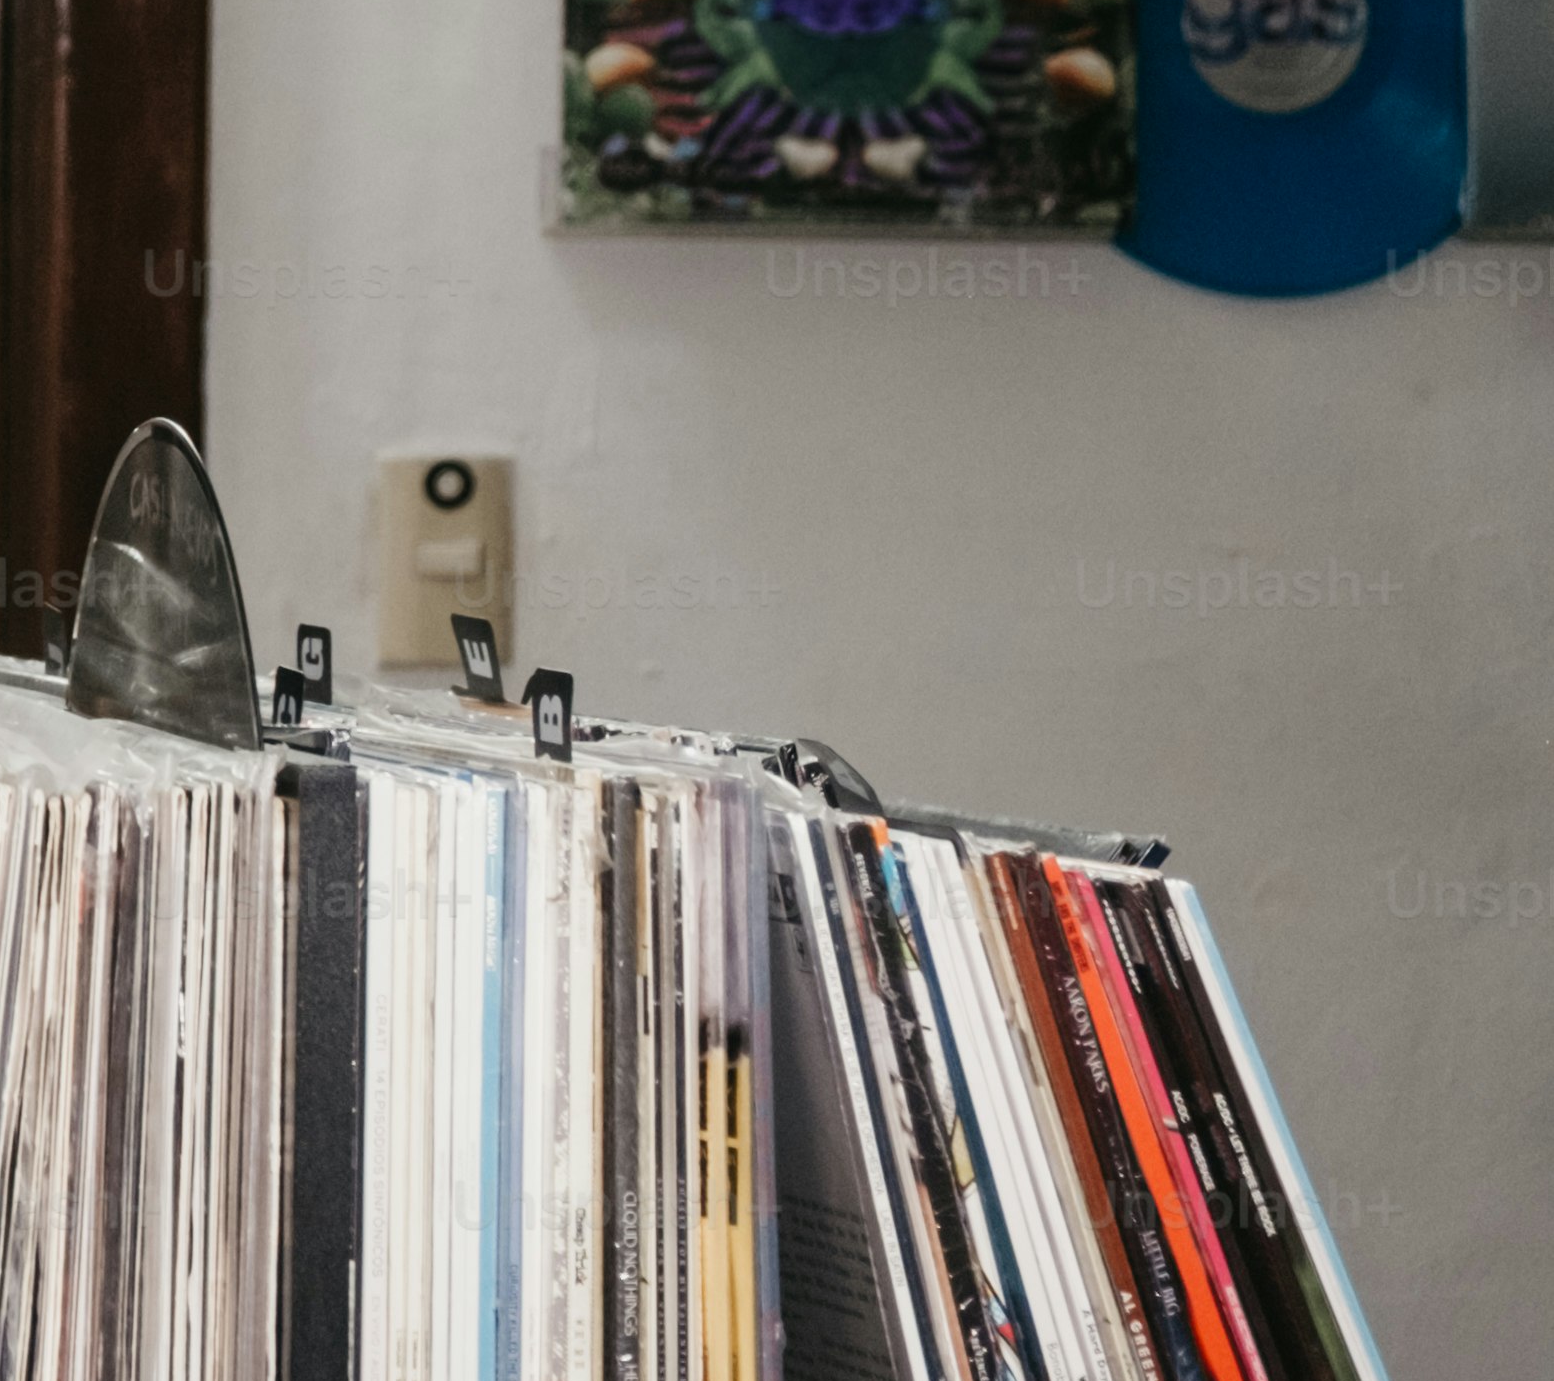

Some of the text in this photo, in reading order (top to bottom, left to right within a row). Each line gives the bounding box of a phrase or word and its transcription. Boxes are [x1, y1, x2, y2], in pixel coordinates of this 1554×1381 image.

[302, 636, 323, 681] G
[462, 638, 493, 679] E
[539, 694, 563, 745] B
[820, 940, 840, 989] HOLIDAY
[374, 994, 387, 1051] CERATI
[831, 991, 847, 1021] WITH
[838, 1021, 852, 1044] RAY
[1057, 971, 1095, 1038] AARON
[1078, 1036, 1113, 1095] PARKS
[375, 1069, 385, 1083] 14
[372, 1089, 387, 1175] EPISODIOS
[860, 1125, 886, 1196] ORCHESTRA
[1185, 1130, 1217, 1193] POWERAGE
[1249, 1187, 1266, 1205] BE
[369, 1179, 386, 1278] SINFÓNICOS
[623, 1191, 637, 1247] CLOUD
[879, 1208, 894, 1239] LADY
[1255, 1203, 1279, 1238] ROCK
[886, 1240, 898, 1253] IN
[507, 1264, 519, 1315] CURIOSITY
[889, 1254, 905, 1288] SATIN
[623, 1251, 638, 1336] NOTHINGS
[1118, 1288, 1137, 1314] AL
[1157, 1285, 1182, 1318] BIG
[1081, 1307, 1091, 1319] A
[507, 1319, 518, 1353] KILLED
[573, 1318, 586, 1369] WE'RE
[1085, 1322, 1102, 1355] Hard
[507, 1358, 518, 1374] THE
